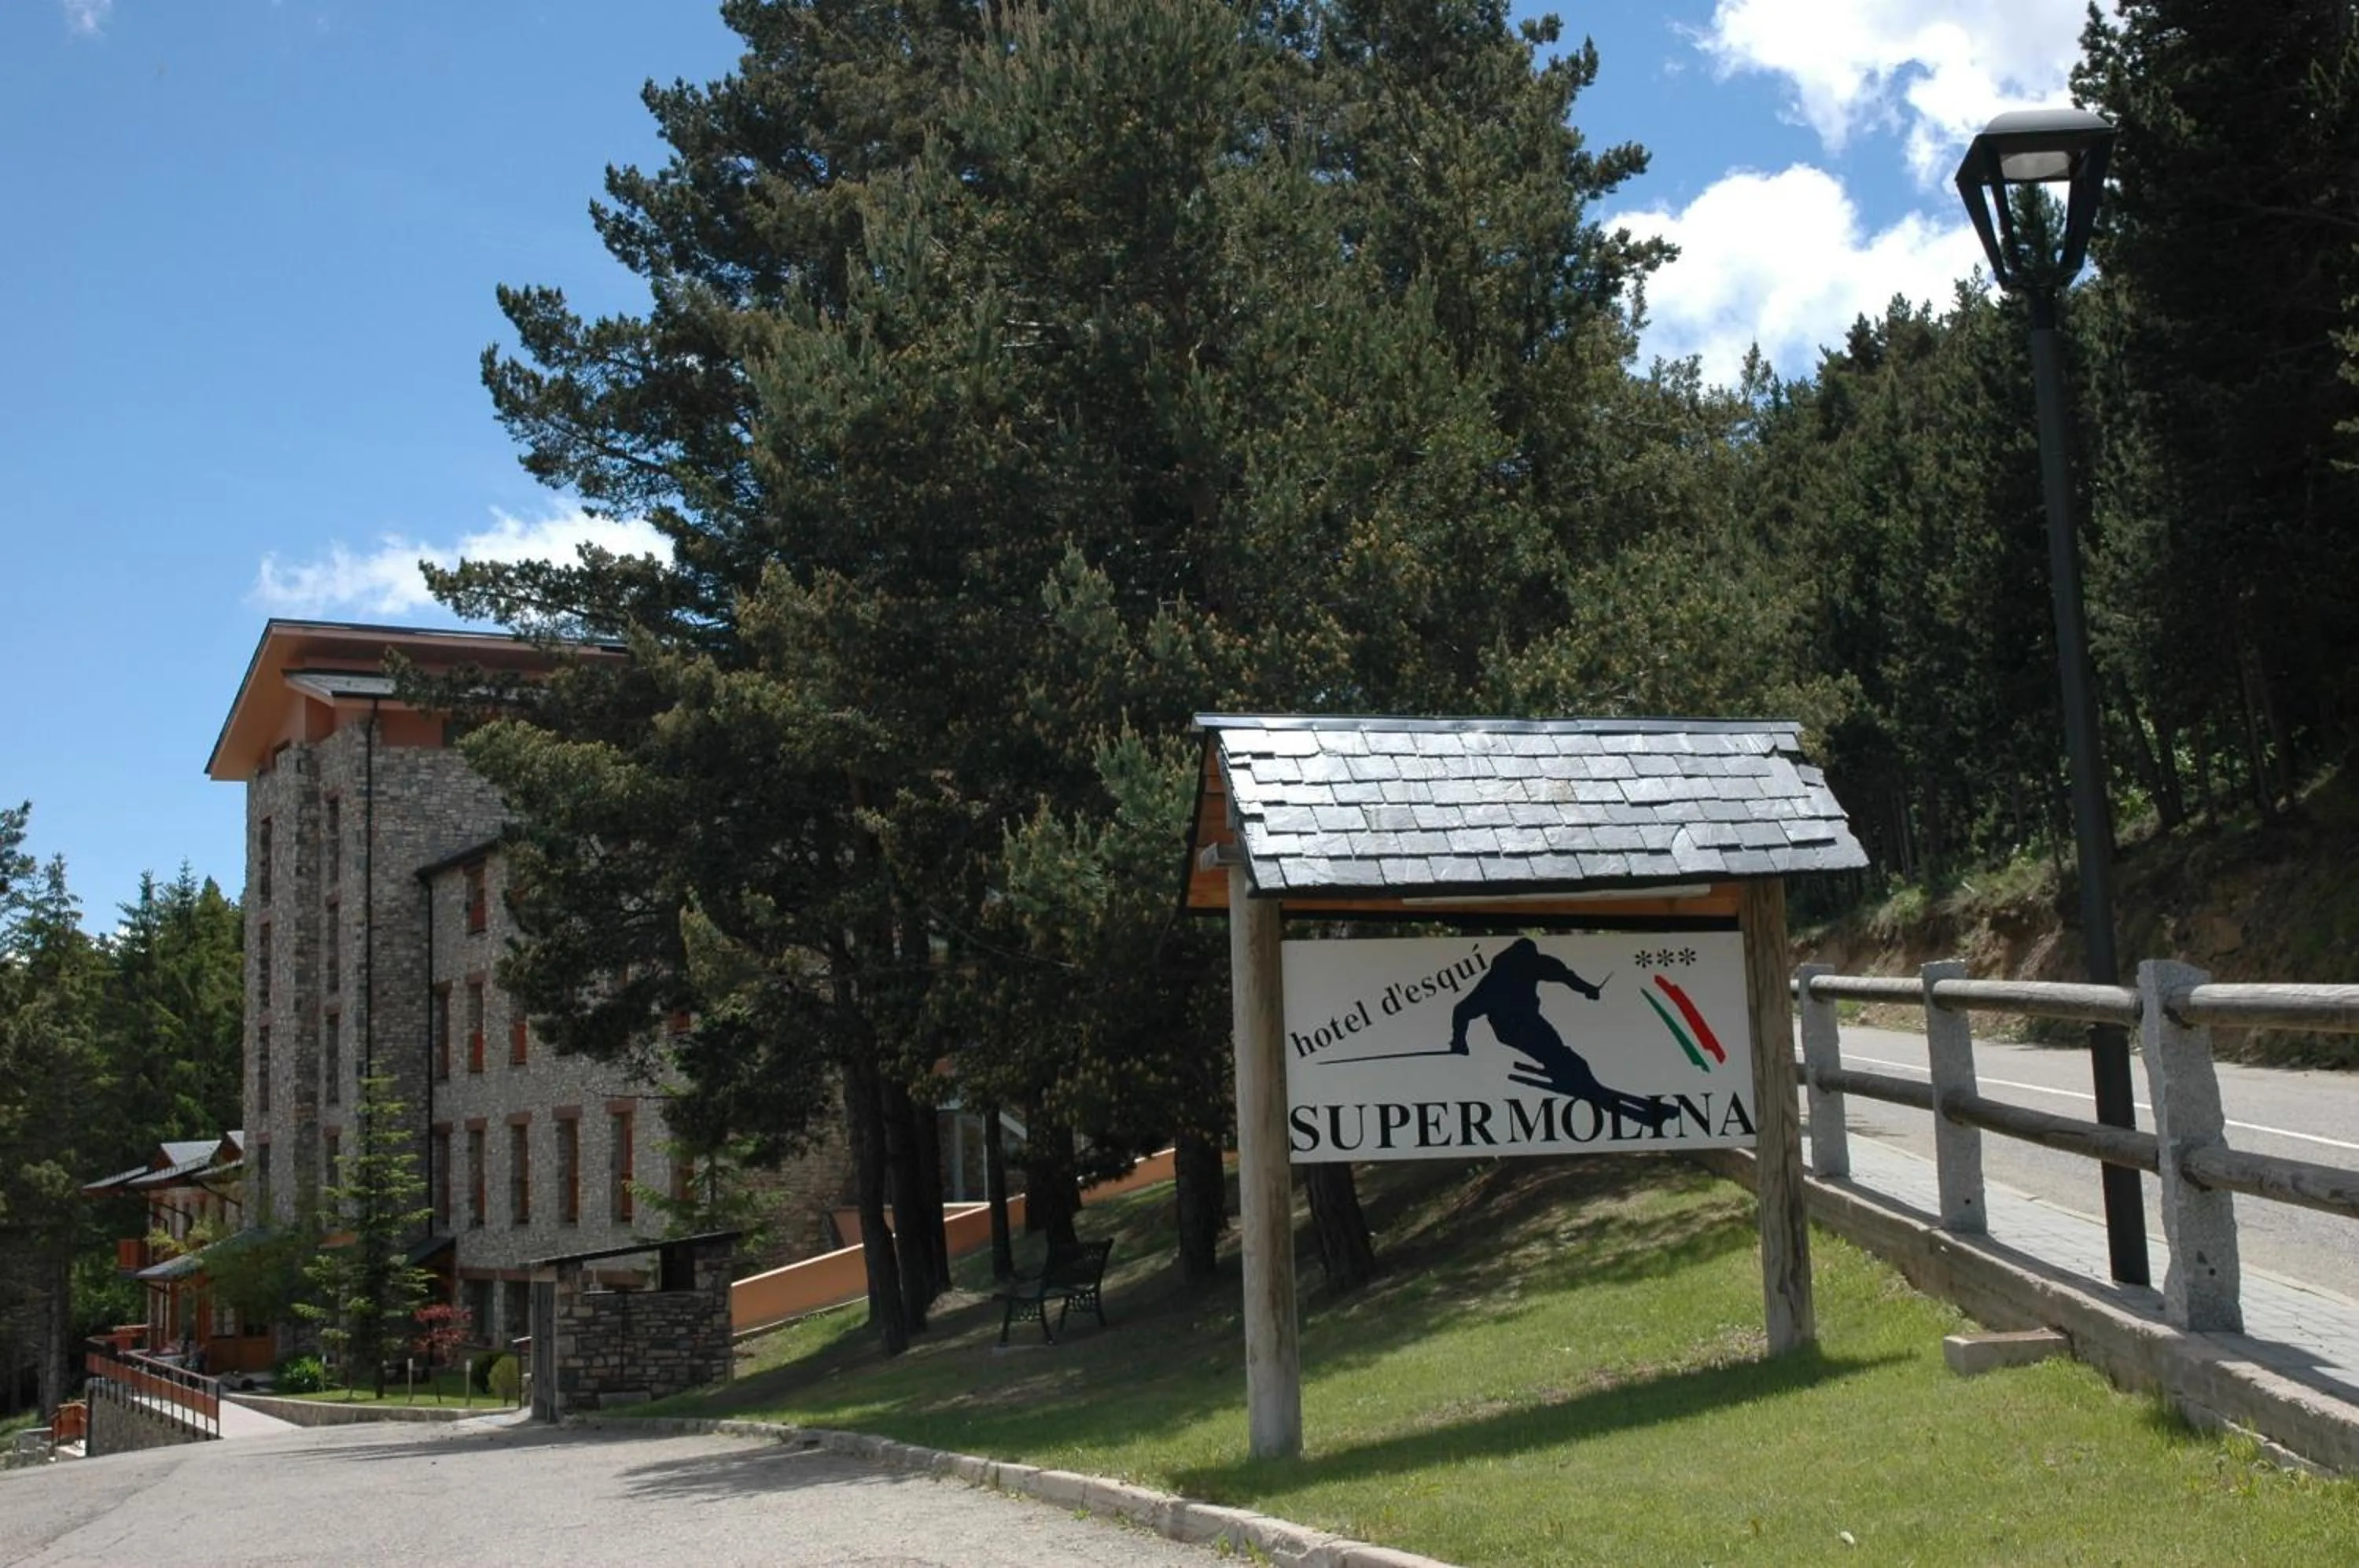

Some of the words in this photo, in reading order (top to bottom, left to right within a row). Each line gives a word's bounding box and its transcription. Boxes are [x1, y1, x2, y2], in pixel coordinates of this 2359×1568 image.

[1290, 999, 1373, 1058] hotel
[1381, 943, 1488, 1016] d'esquí
[1290, 1091, 1757, 1152] SUPERMOLINA
